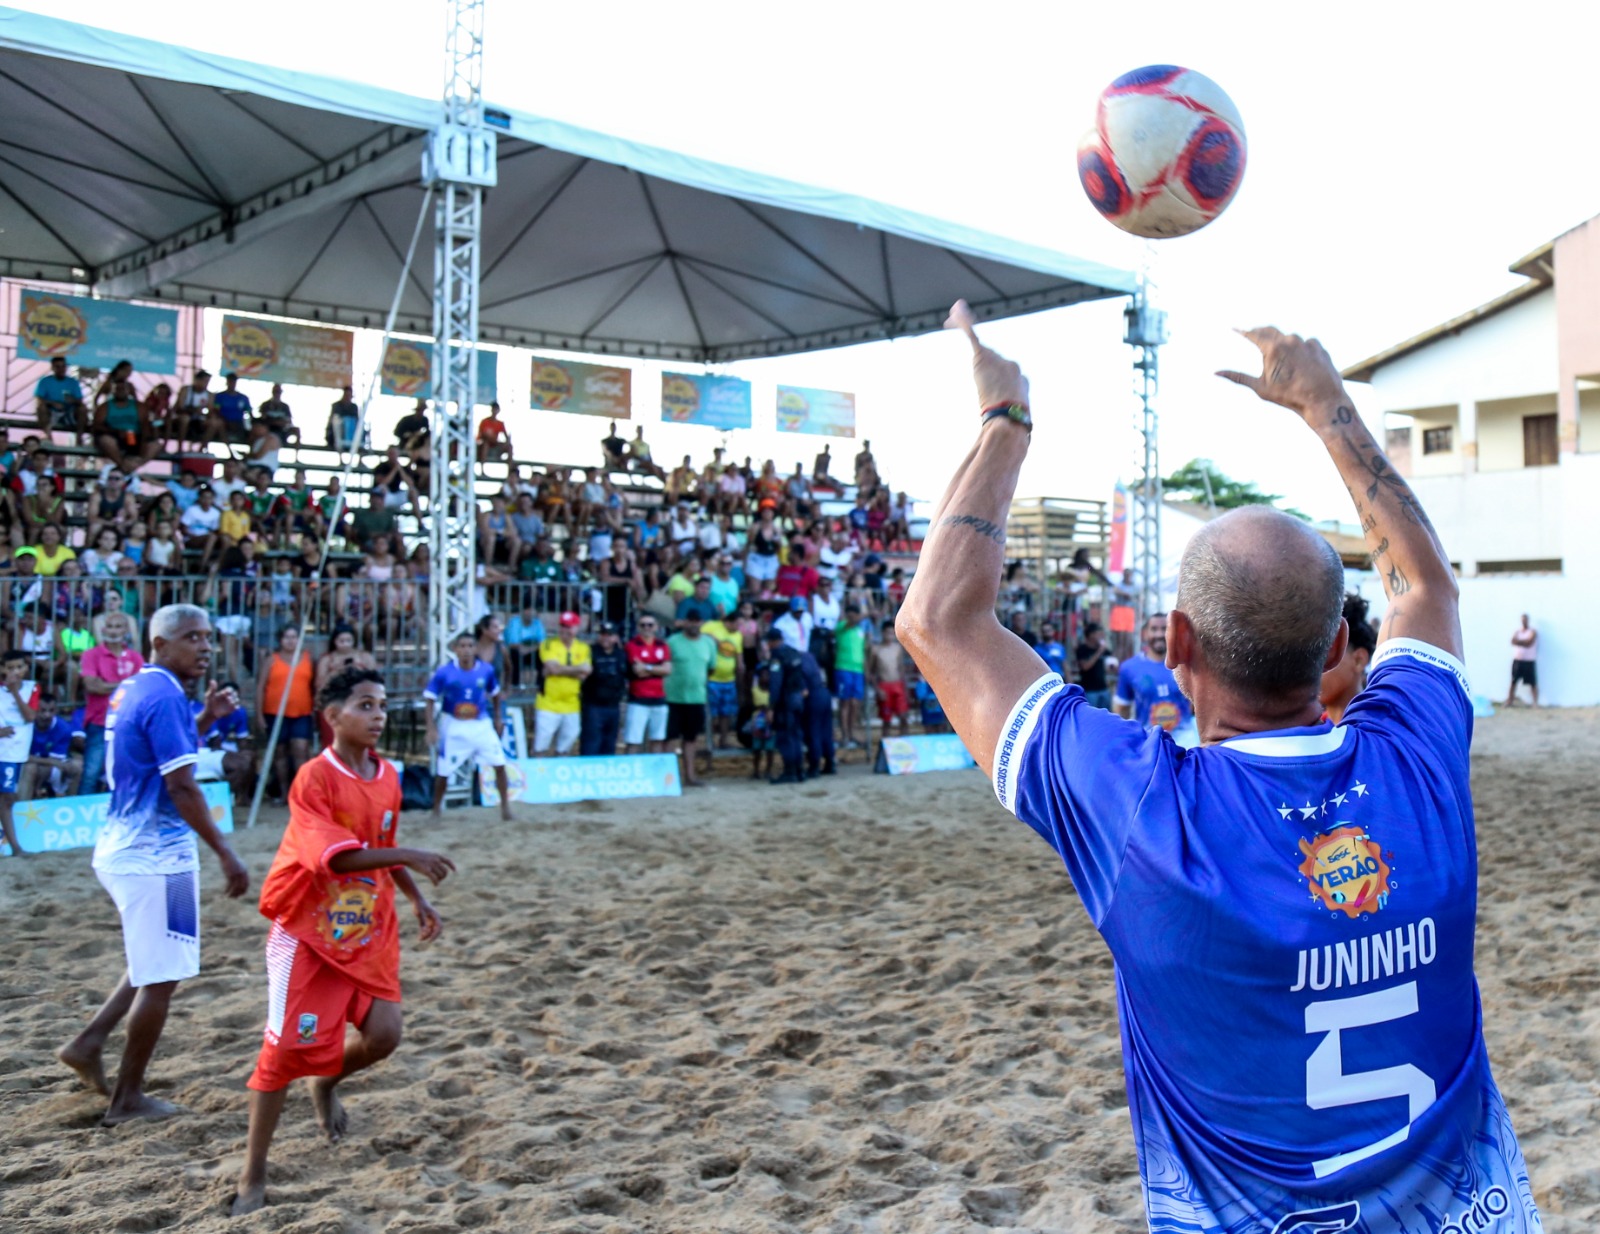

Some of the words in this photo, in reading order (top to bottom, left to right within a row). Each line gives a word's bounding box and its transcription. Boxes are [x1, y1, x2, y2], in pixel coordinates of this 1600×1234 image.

[1023, 689, 1045, 711] BRAZIL
[1007, 710, 1029, 741] LEGEND
[998, 740, 1014, 767] BEACH
[555, 766, 571, 781] O
[573, 760, 631, 779] VERÃO
[997, 766, 1008, 795] SOCCER
[550, 781, 597, 798] PARA
[597, 779, 656, 797] TODOS
[54, 807, 75, 825] O
[78, 804, 109, 823] VE
[1310, 854, 1380, 889] VERÃO
[1290, 917, 1437, 992] JUNINHO
[1304, 980, 1437, 1179] 5
[1440, 1186, 1509, 1234] ério
